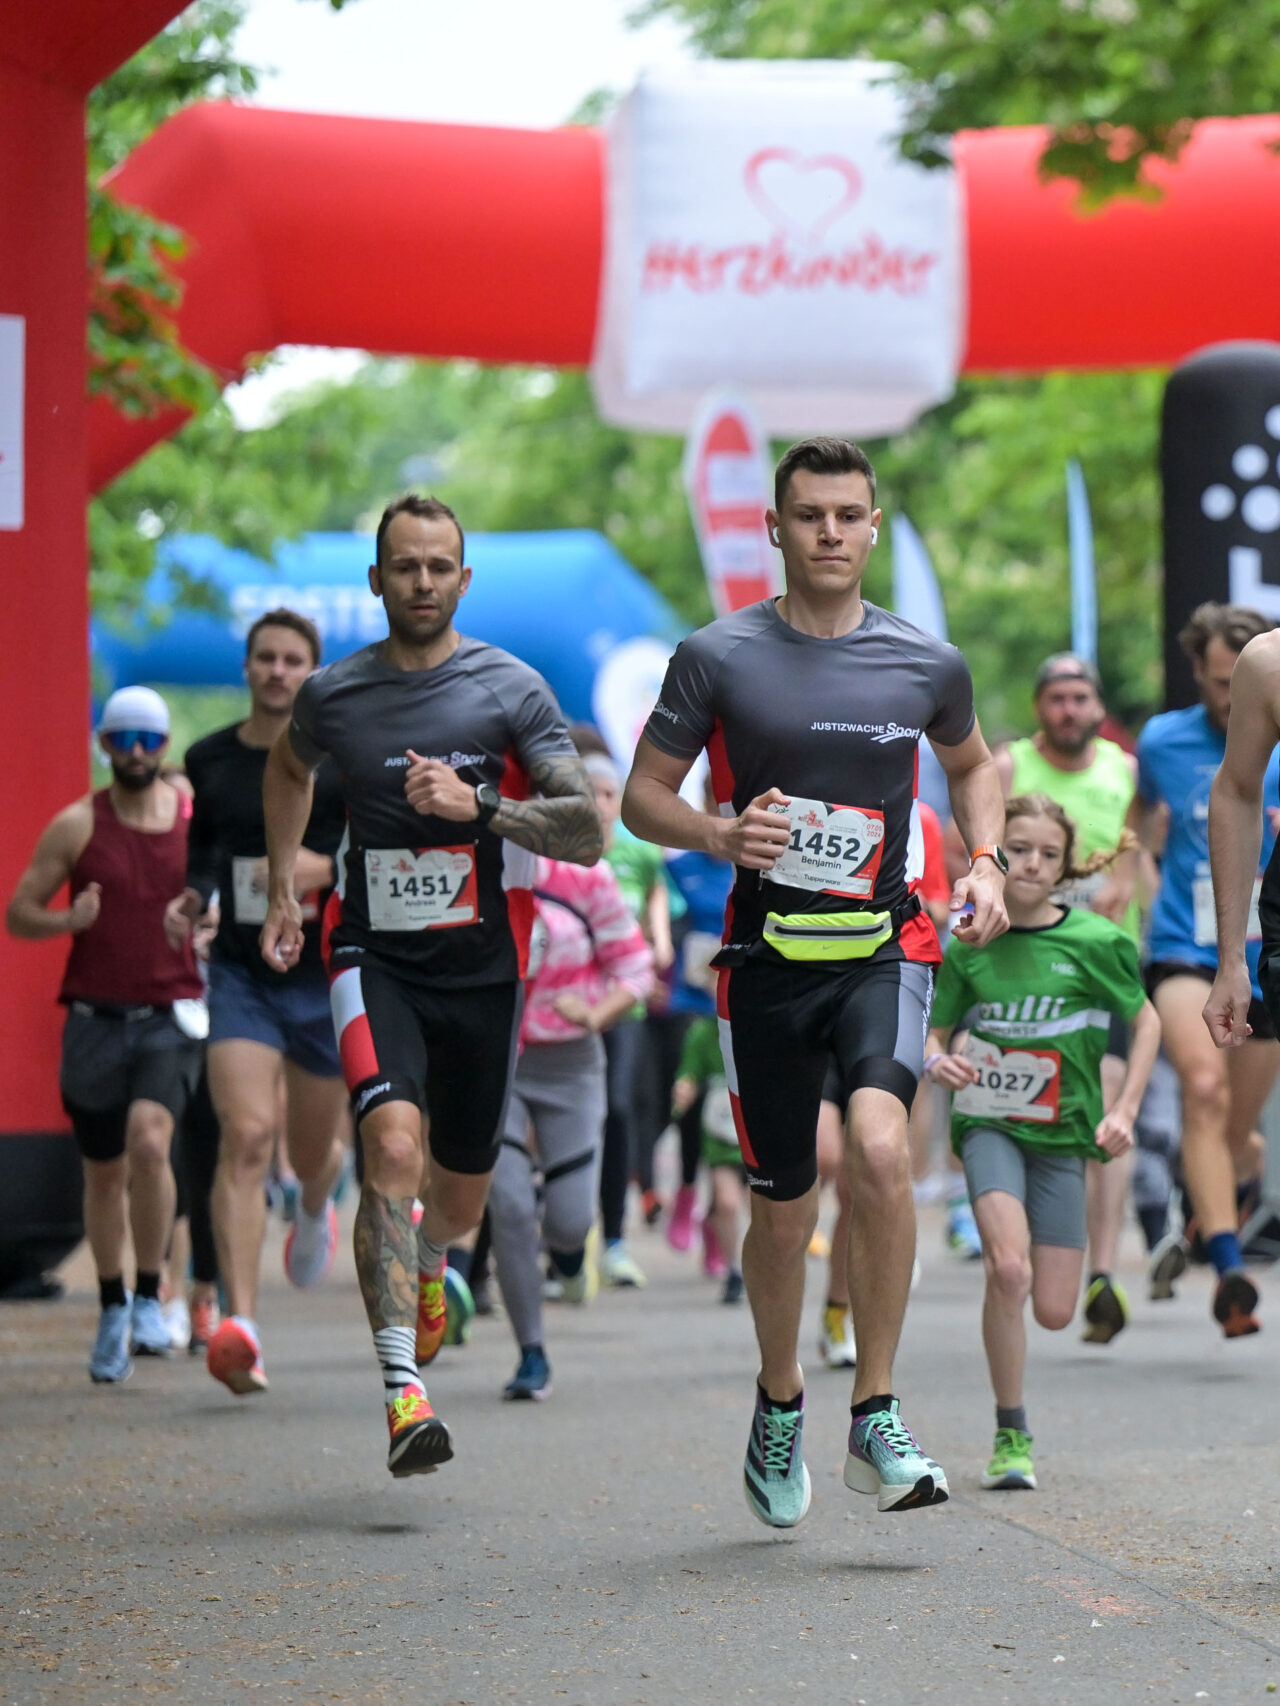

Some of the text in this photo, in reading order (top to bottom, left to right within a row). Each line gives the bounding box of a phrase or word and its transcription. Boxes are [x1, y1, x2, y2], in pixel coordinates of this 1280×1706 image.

[810, 721, 921, 740] JUSTIZWACHE Sport
[788, 829, 861, 861] 1452
[801, 855, 842, 869] Benjamin
[388, 874, 452, 898] 1451
[804, 873, 841, 886] Tupperware
[977, 1067, 1034, 1092] 1027
